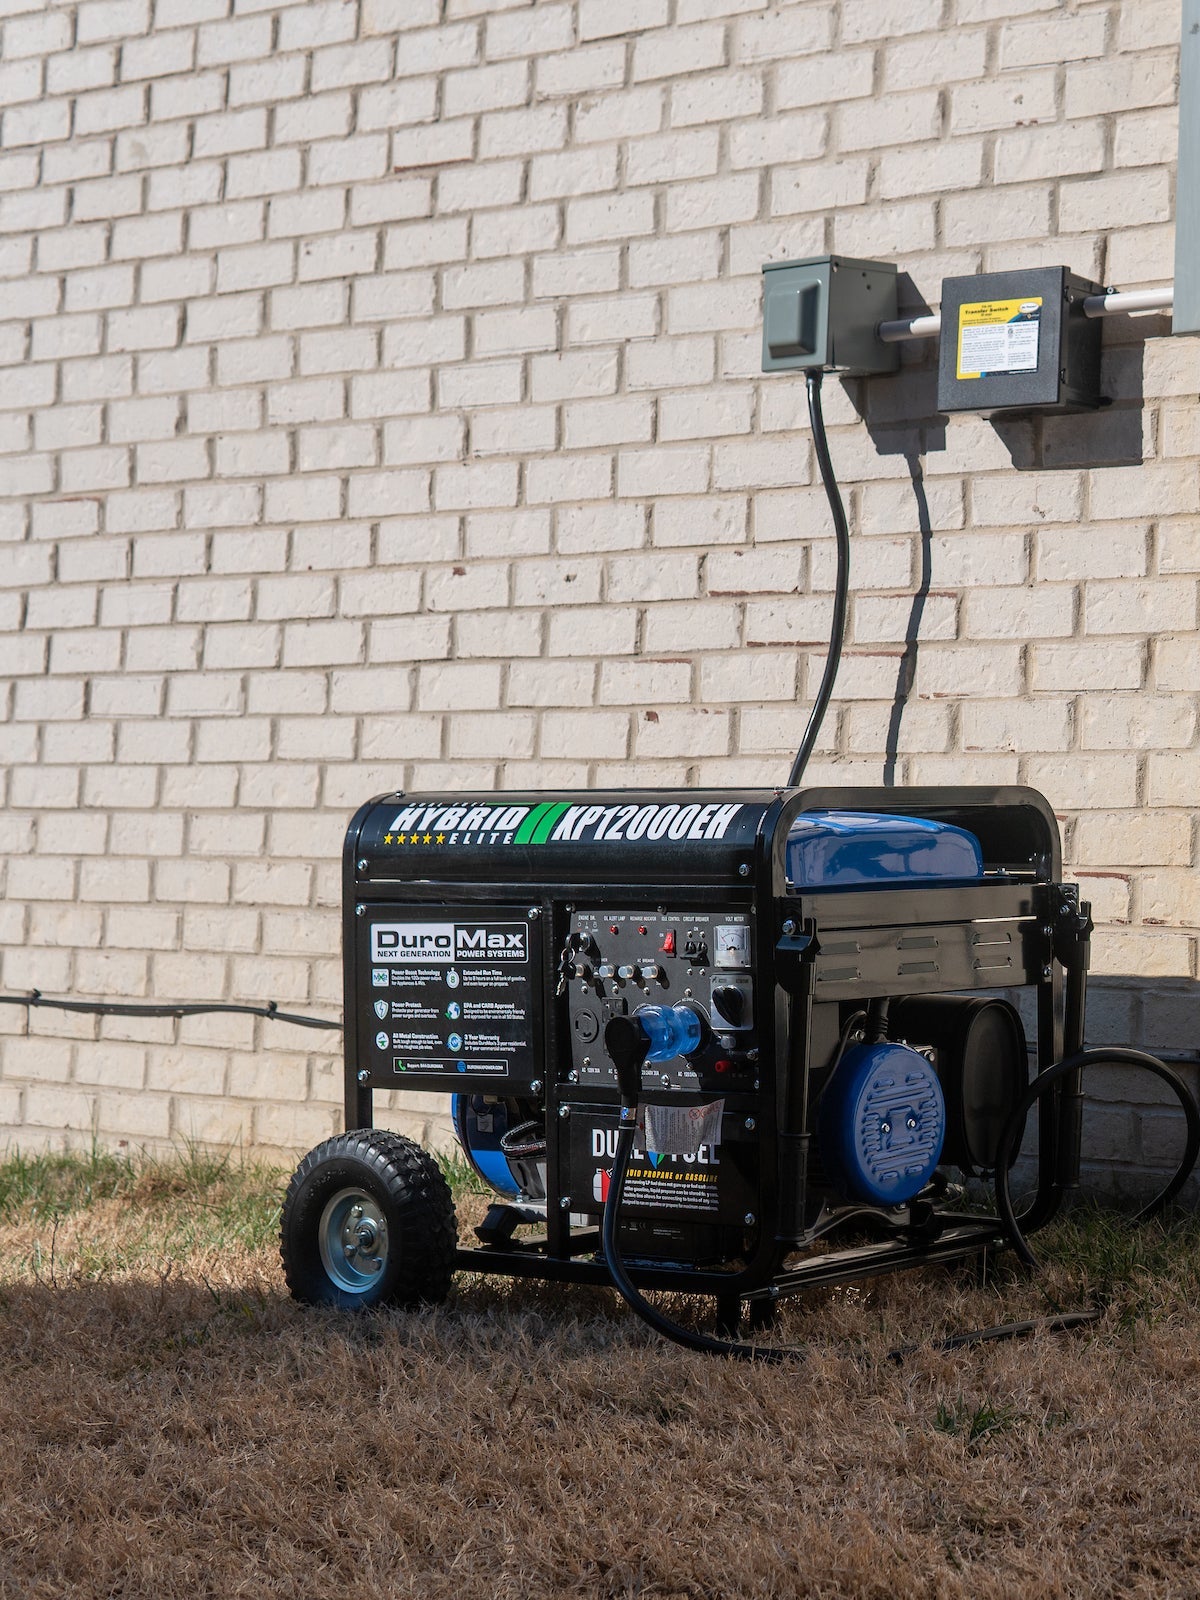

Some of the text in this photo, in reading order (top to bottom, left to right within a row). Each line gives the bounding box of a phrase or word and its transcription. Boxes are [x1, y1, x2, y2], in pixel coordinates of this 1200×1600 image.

[388, 806, 531, 832] HYBRID
[550, 803, 745, 841] XP12000EH
[448, 832, 514, 845] ELITE
[377, 929, 524, 948] Duro Max
[457, 950, 485, 958] POWER
[487, 950, 524, 958] SYSTEMS
[643, 1170, 673, 1180] PROPANE
[674, 1173, 684, 1181] or
[686, 1173, 717, 1182] GASOLINE
